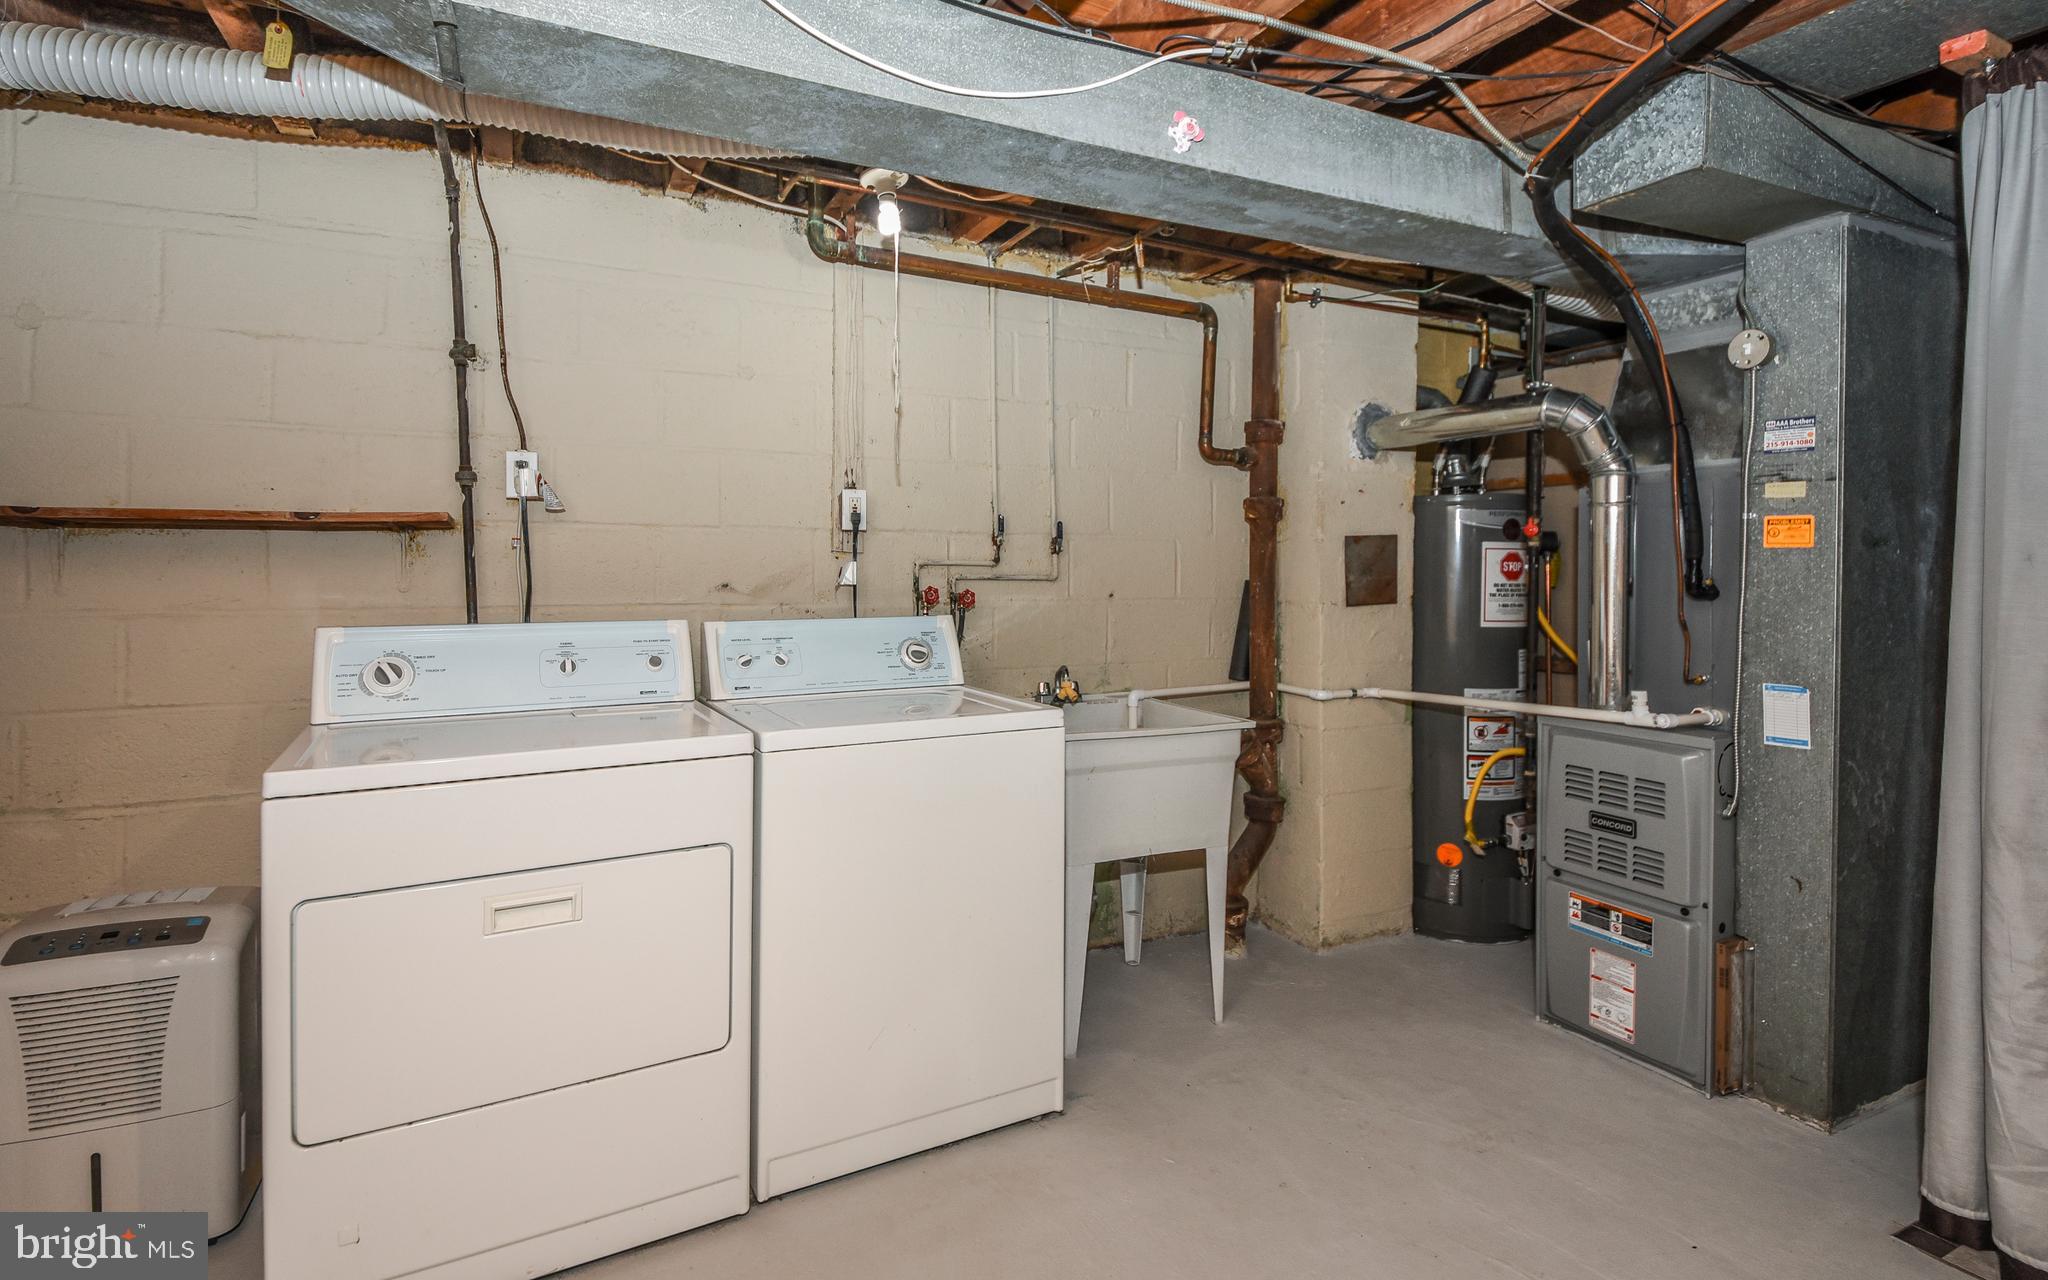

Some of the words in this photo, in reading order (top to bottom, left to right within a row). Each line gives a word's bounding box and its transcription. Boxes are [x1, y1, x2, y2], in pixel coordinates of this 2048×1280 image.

[1776, 419, 1788, 427] AAA
[1789, 417, 1815, 426] Brothers
[1765, 438, 1814, 448] 215-914-1080
[1503, 561, 1522, 572] STOP
[1591, 817, 1632, 832] CONCORD
